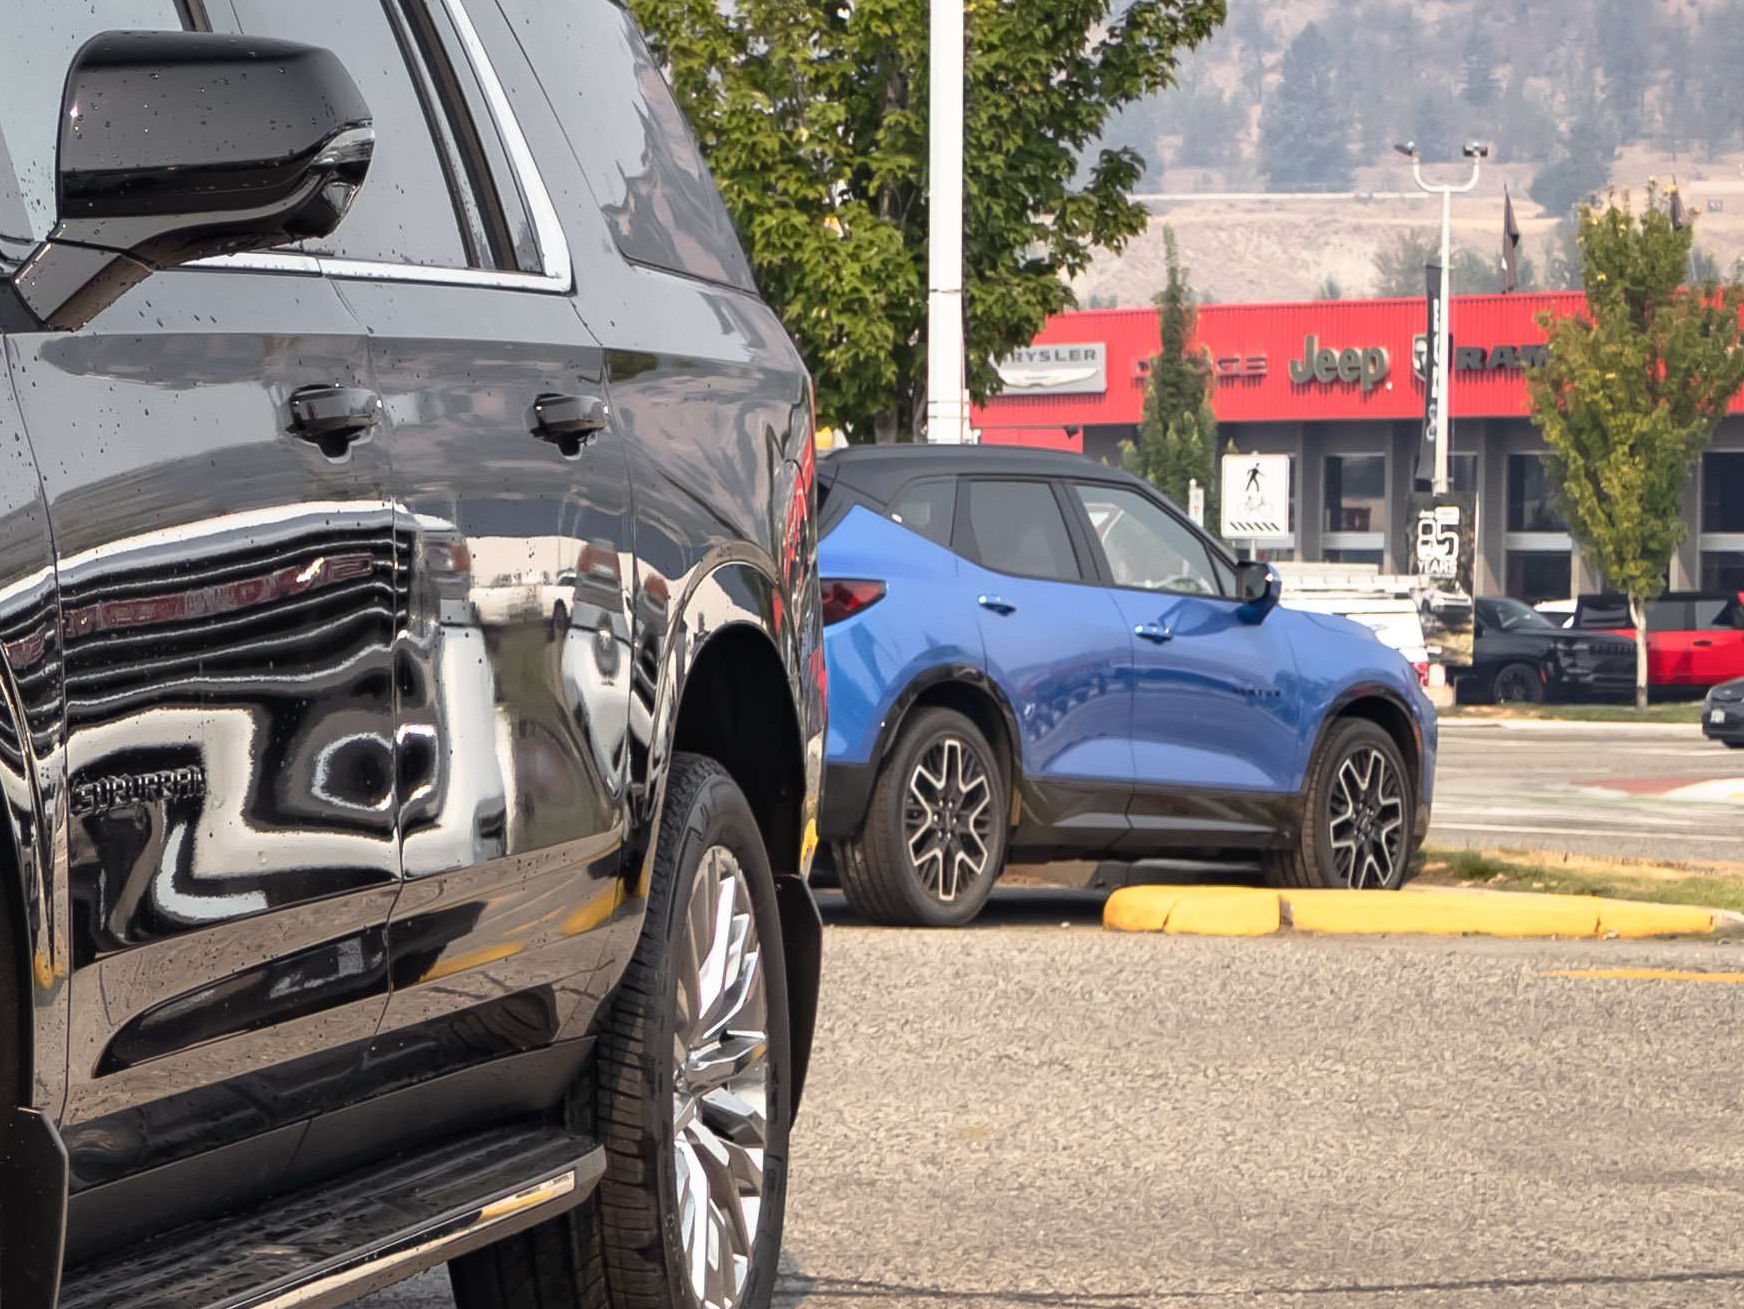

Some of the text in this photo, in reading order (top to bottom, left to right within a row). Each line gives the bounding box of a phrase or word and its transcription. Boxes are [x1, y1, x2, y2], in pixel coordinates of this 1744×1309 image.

[1004, 347, 1097, 363] RYSLER
[1289, 334, 1390, 392] Jeep
[1454, 345, 1550, 371] RAM
